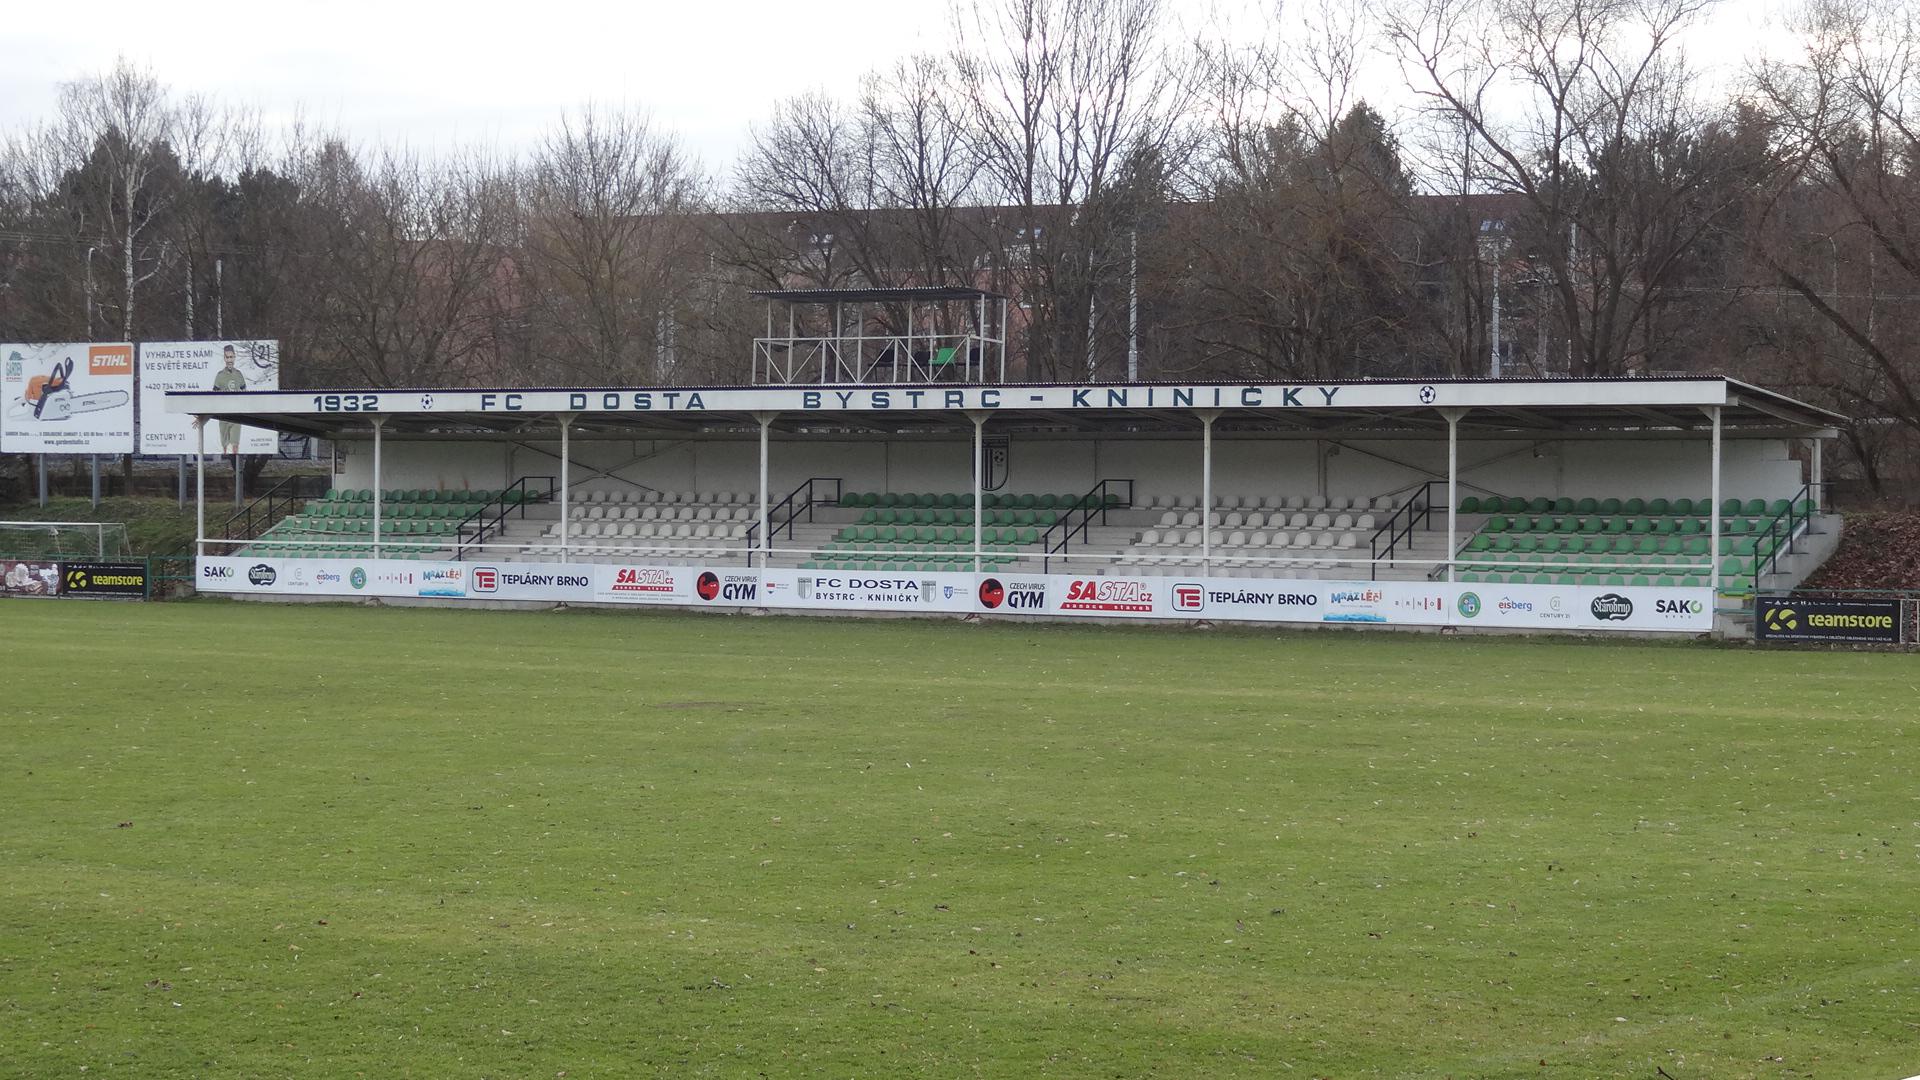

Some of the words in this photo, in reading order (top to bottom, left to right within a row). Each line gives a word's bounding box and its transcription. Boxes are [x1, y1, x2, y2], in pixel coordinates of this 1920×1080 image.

[92, 355, 128, 366] STIHL
[145, 350, 184, 358] VYHRAJTE
[157, 361, 180, 370] SVĚTĚ
[314, 395, 378, 412] 1932
[481, 394, 522, 411] FC
[570, 393, 705, 410] DOSTA
[802, 390, 1000, 409] BYSTRC
[204, 566, 234, 578] SAKO
[317, 572, 340, 582] eisberg
[616, 569, 665, 584] SASTA
[92, 575, 143, 586] teamstore
[502, 572, 554, 586] TEPLÁRNY
[557, 576, 589, 587] BRNO
[816, 578, 842, 588] FC
[849, 579, 918, 590] DOSTA
[723, 584, 756, 600] GYM
[816, 592, 855, 600] BYSTRC
[1067, 580, 1138, 602] SASTA
[1008, 591, 1044, 608] GYM
[1208, 590, 1274, 604] TEPLÁRNY
[1278, 594, 1317, 606] BRNO
[1498, 600, 1532, 611] eisberg
[1656, 600, 1702, 614] SAKO
[1808, 614, 1892, 628] teamstore
